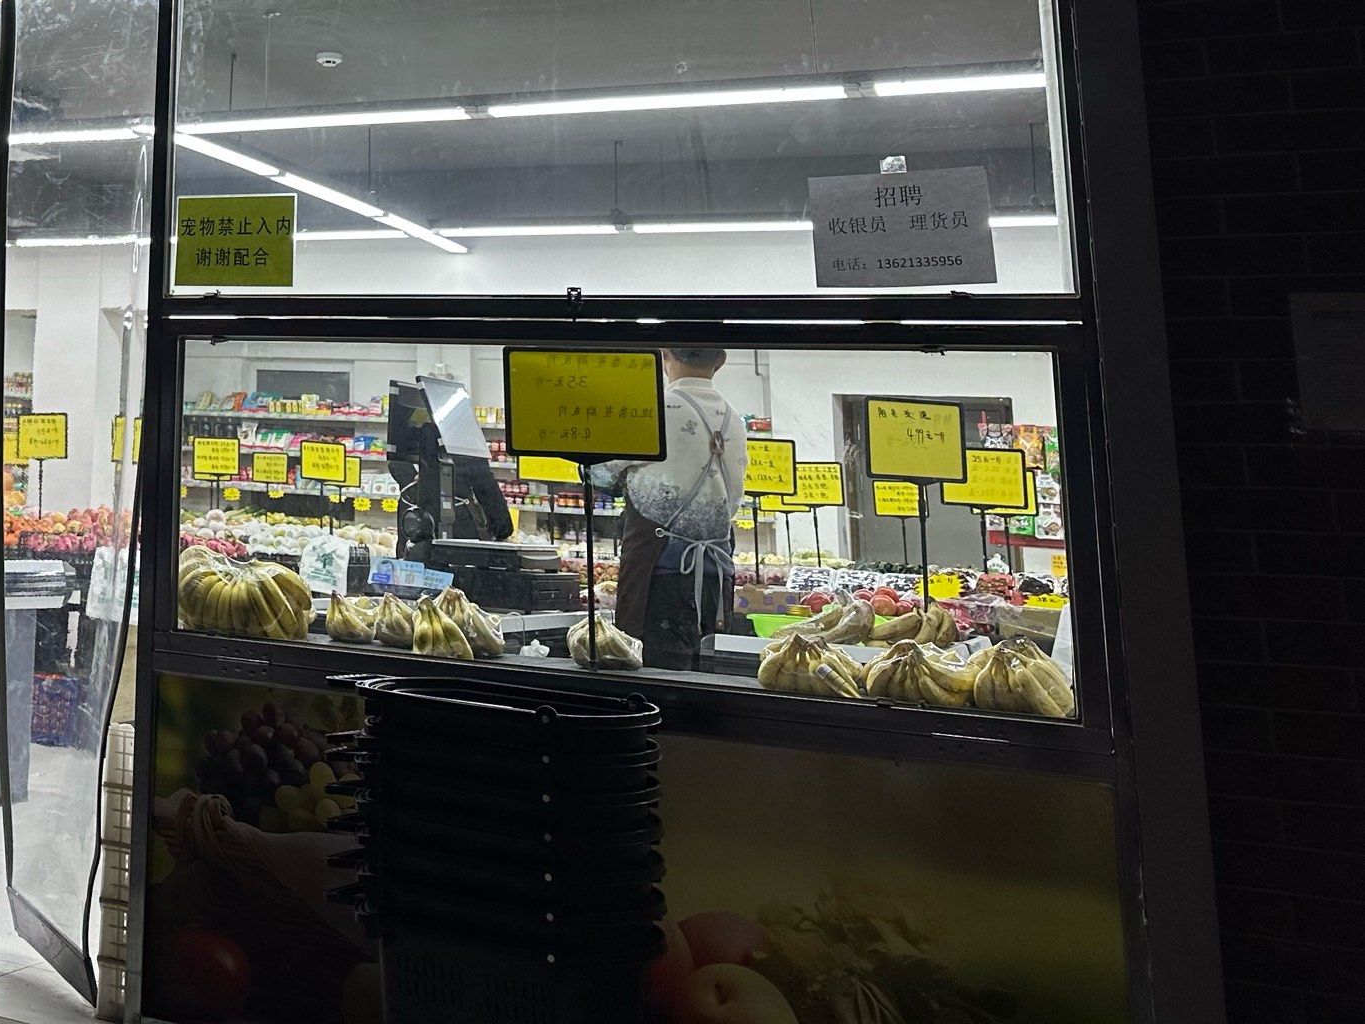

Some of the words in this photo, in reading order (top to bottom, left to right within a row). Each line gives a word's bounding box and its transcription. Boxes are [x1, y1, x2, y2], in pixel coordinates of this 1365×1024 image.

[874, 184, 924, 209] 招聘
[181, 216, 291, 236] 宠物禁止入内
[828, 214, 887, 236] 收银员
[909, 210, 969, 232] 理货员
[195, 247, 269, 267] 谢谢配合
[877, 255, 963, 269] 13621335956
